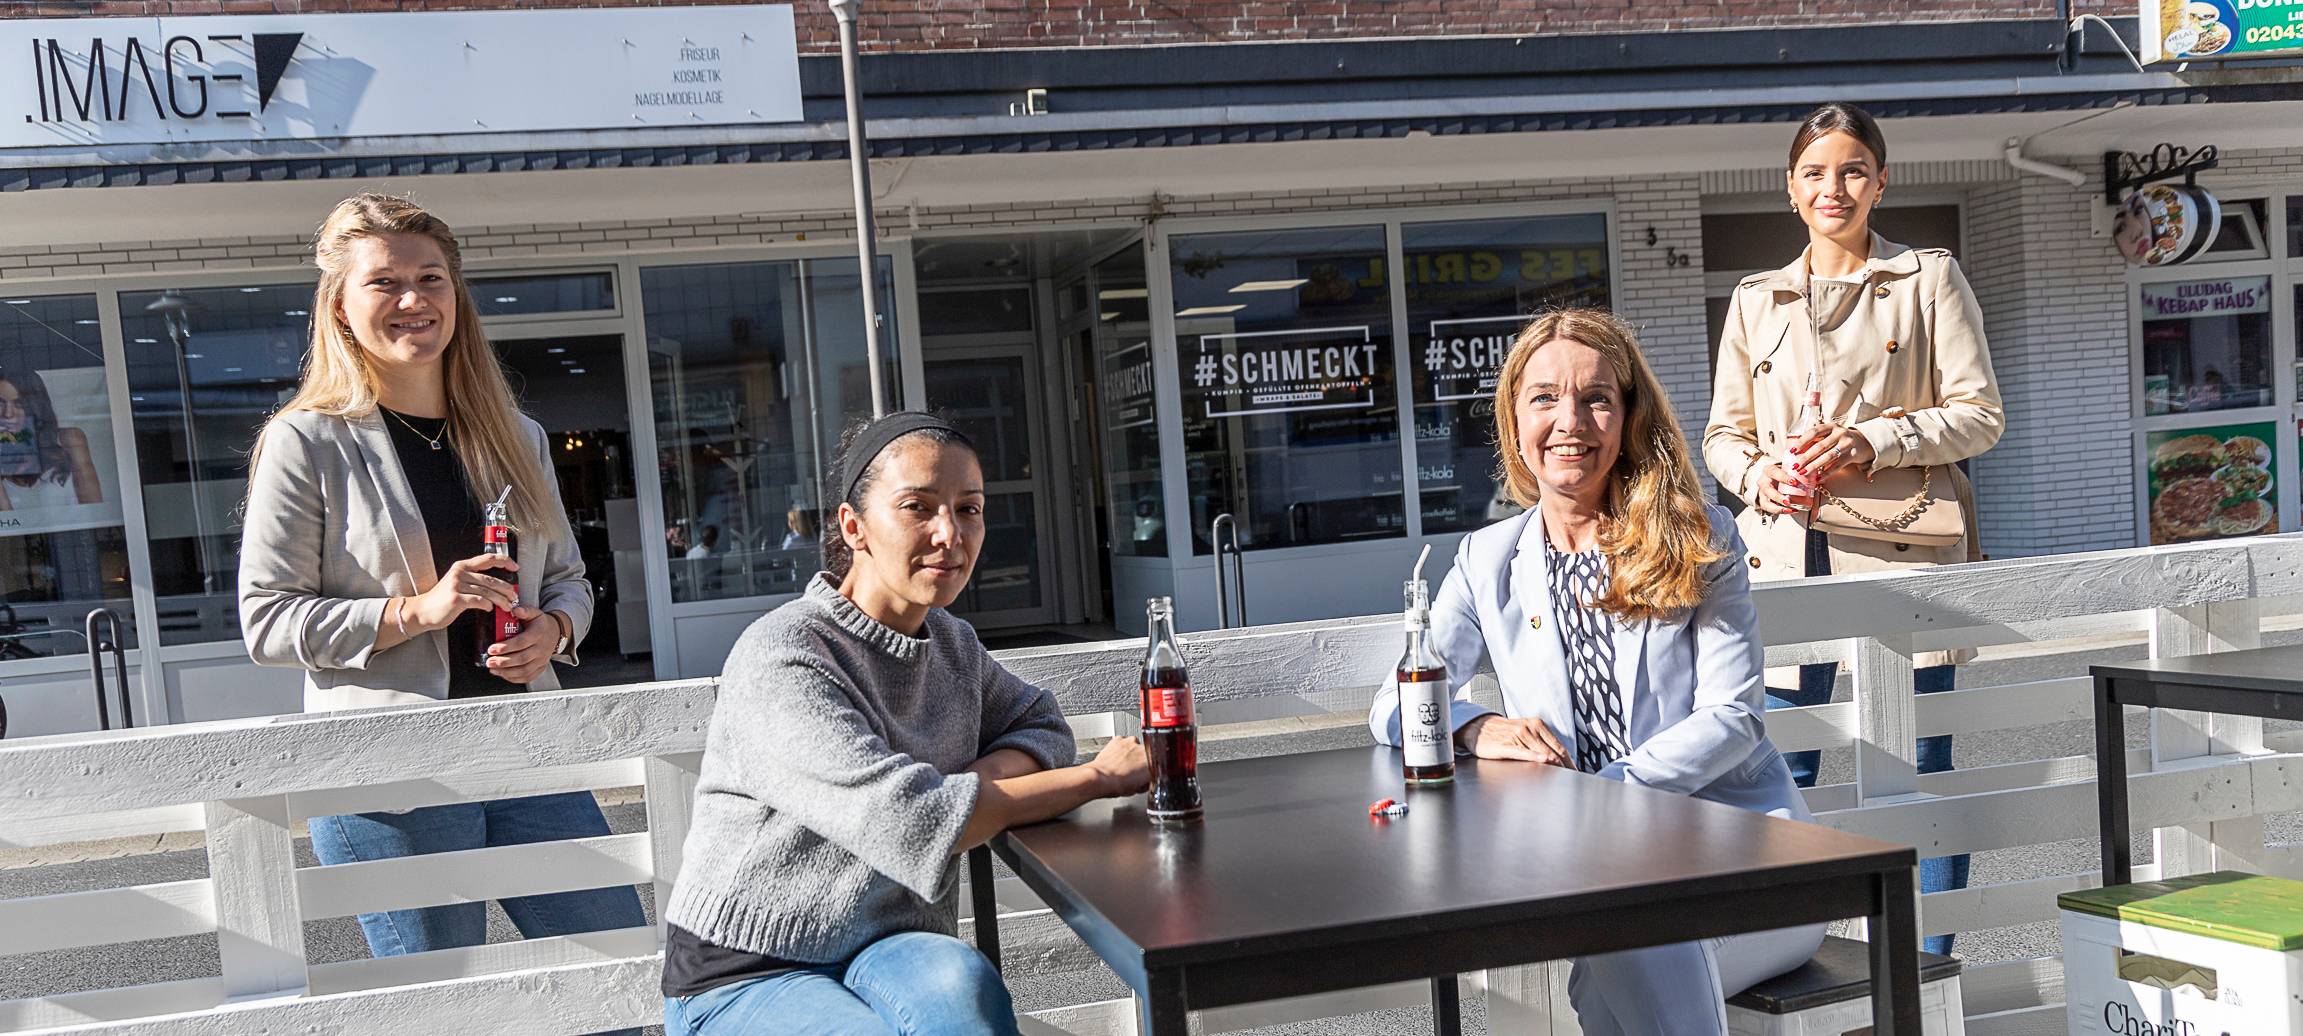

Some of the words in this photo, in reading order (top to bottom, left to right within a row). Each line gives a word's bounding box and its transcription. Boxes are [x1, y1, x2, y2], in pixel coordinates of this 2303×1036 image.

[1647, 227, 1657, 247] 3
[1666, 246, 1690, 267] 3a
[2176, 281, 2233, 298] ULUDAG
[2157, 296, 2209, 315] KEBAP
[2214, 288, 2255, 311] HAUS
[1194, 344, 1377, 387] #SCHMECKT
[1252, 384, 1292, 394] GEFÜLLTE
